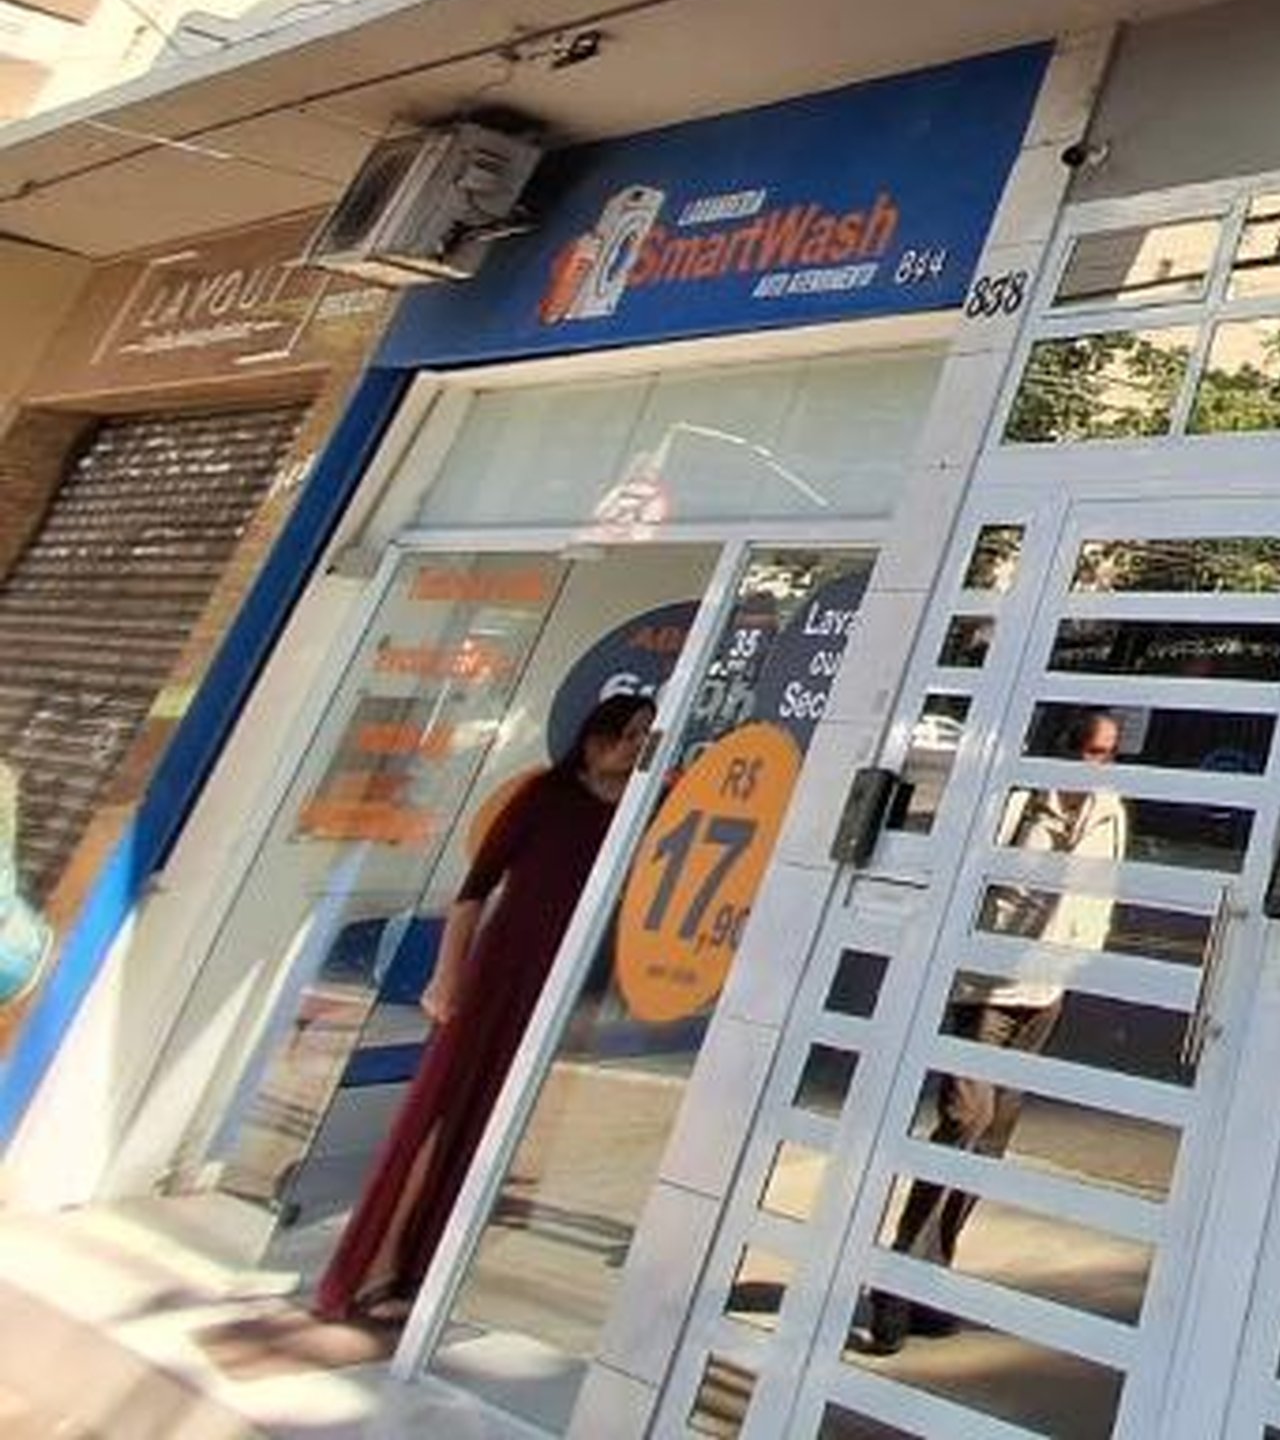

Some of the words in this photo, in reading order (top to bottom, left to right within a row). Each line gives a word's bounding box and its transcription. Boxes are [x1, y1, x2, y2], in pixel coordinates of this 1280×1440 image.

[630, 190, 898, 288] SmartWash
[965, 270, 1030, 318] 858
[719, 757, 764, 799] R$
